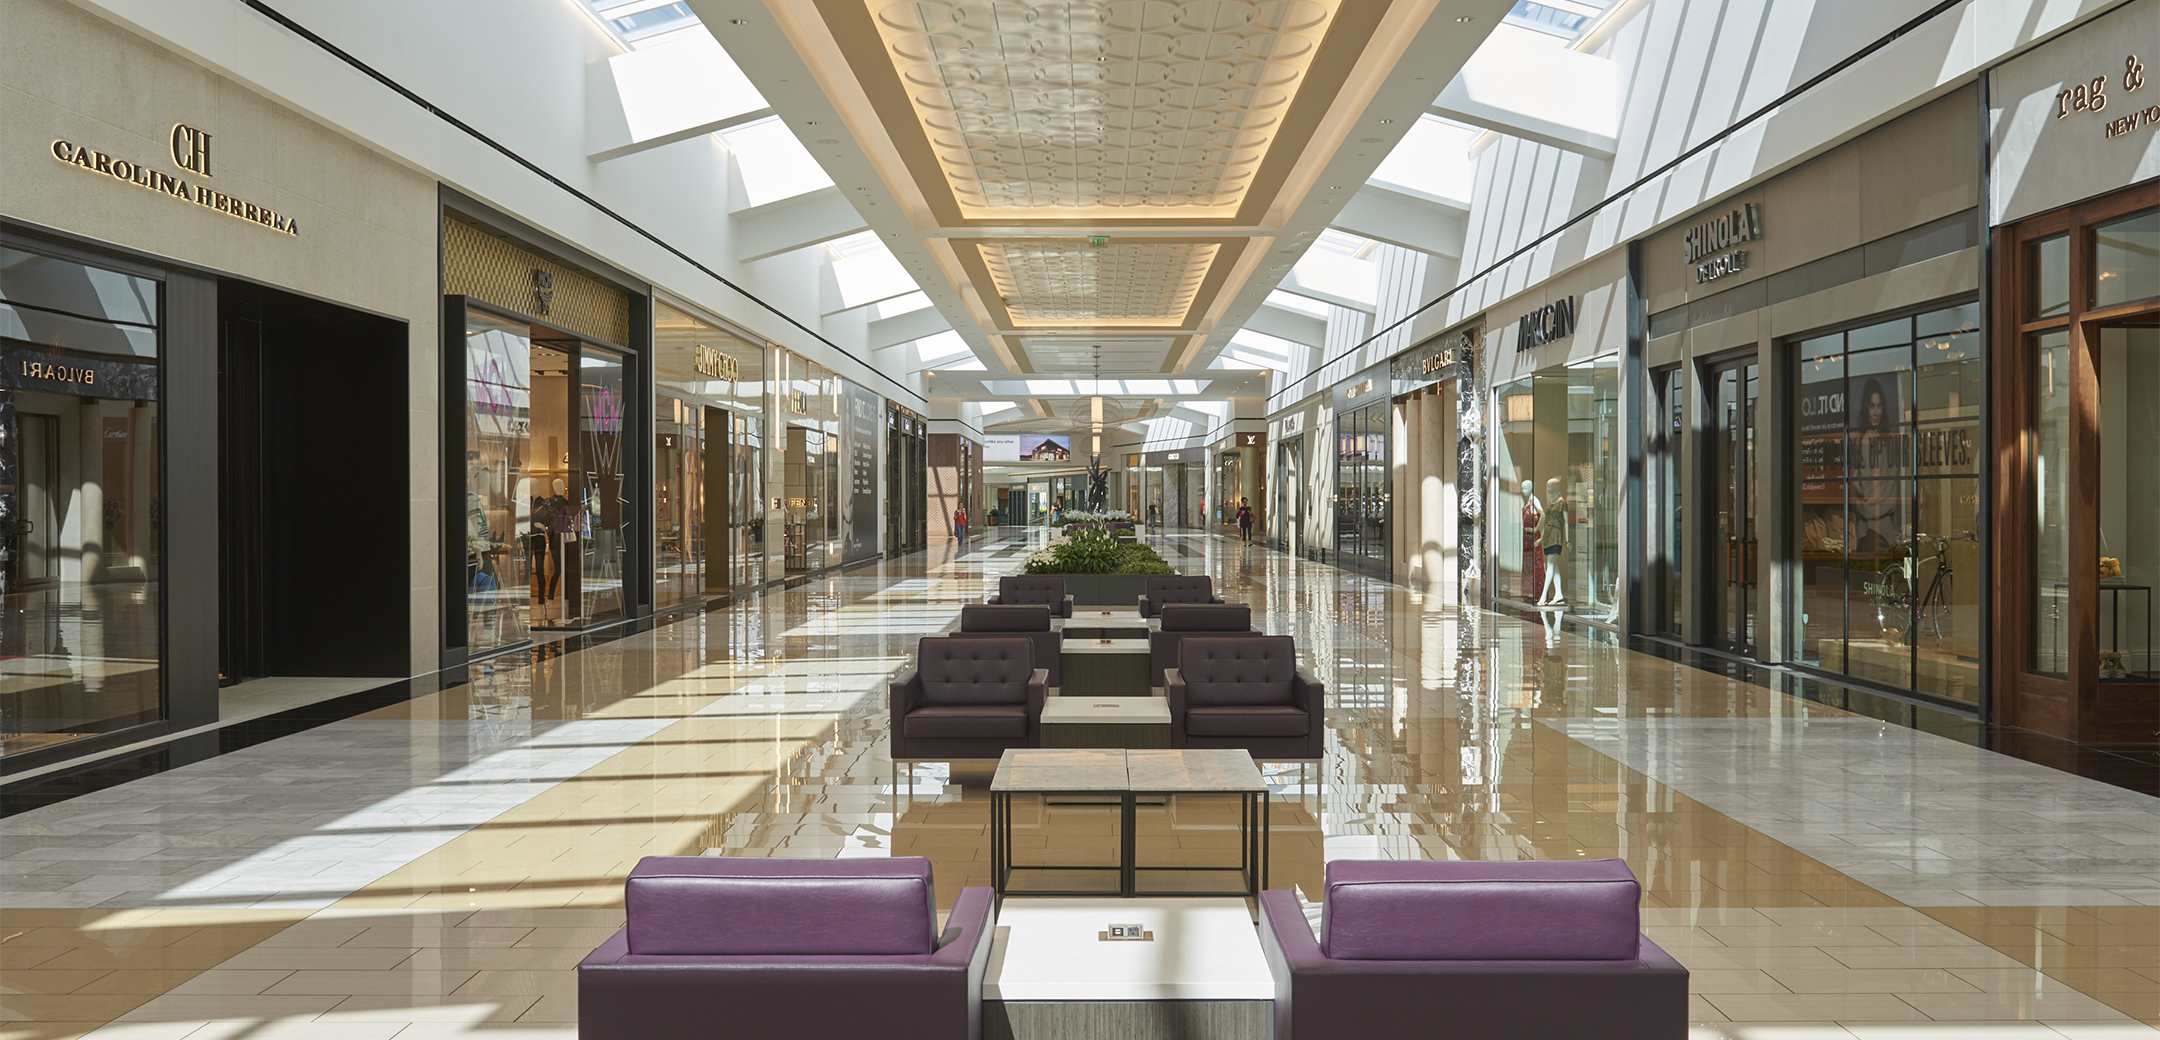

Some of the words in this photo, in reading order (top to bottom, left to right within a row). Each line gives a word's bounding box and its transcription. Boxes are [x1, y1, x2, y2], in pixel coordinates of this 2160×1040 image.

[2056, 74, 2107, 120] rag
[2123, 54, 2145, 93] &
[2106, 112, 2140, 139] NEW
[170, 122, 213, 178] CH
[51, 139, 193, 201] CAROLINA
[194, 185, 299, 236] HERRERA
[1092, 238, 1106, 248] EXIT
[1683, 203, 1756, 265] SHINOLA
[697, 344, 718, 378] JIMMY
[719, 352, 739, 383] CHOO
[1422, 348, 1453, 375] BVLGARI
[472, 347, 517, 423] MCM
[591, 374, 622, 438] MCM
[104, 427, 128, 438] Cartier
[1868, 436, 1883, 469] UP
[1886, 434, 1909, 468] OUR
[1918, 429, 1970, 466] SLEEVES.
[789, 497, 815, 508] FENDI
[1863, 581, 1896, 598] SHINOLA
